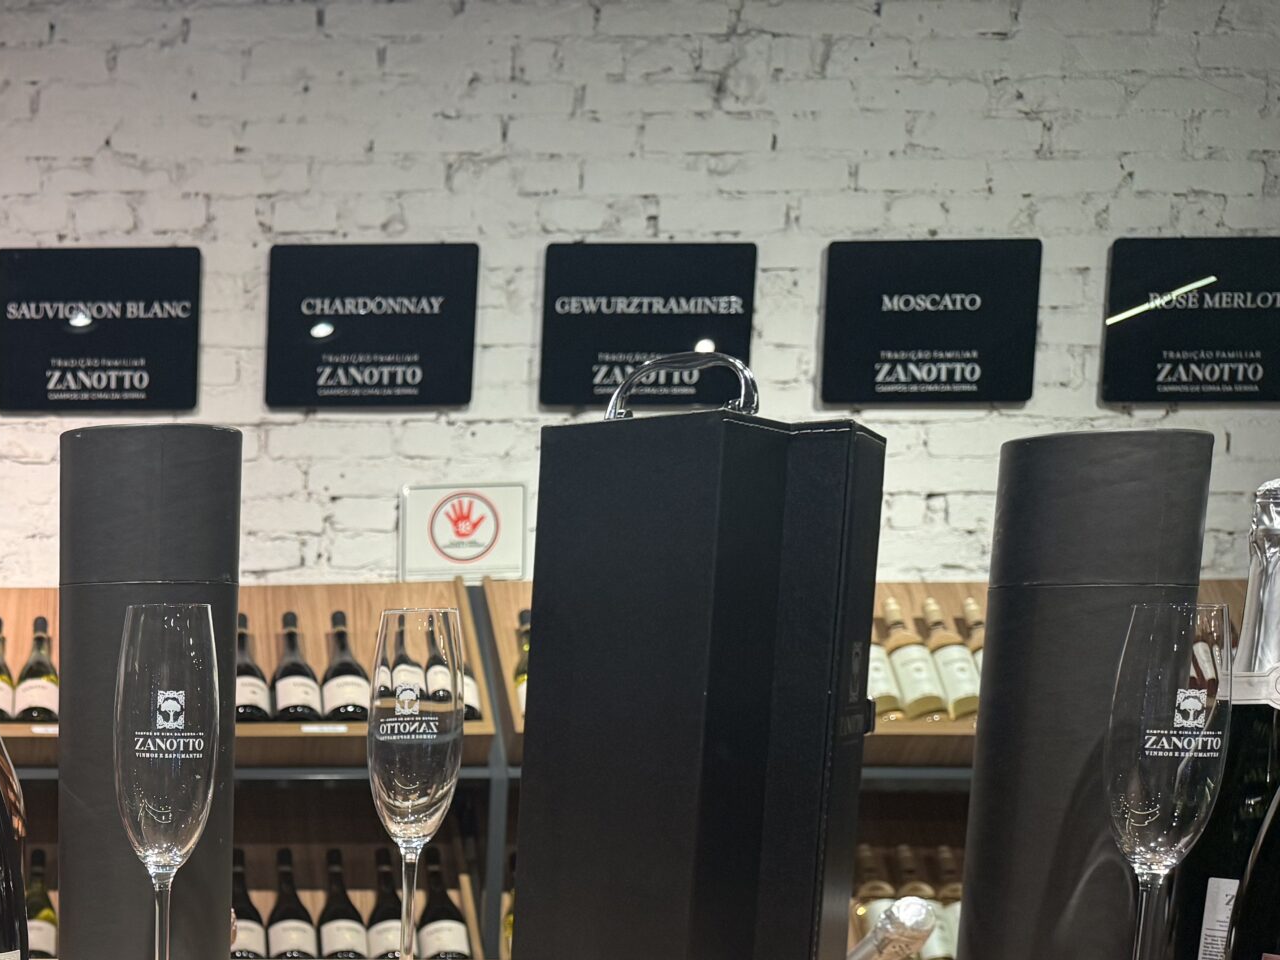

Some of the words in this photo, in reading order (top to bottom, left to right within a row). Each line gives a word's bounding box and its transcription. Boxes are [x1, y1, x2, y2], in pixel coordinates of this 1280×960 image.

[301, 296, 445, 315] CHARDONNAY
[881, 293, 982, 311] MOSCATO
[1203, 292, 1280, 309] MERLOT
[7, 302, 122, 319] SAUVIGNON
[126, 302, 191, 319] BLANC
[45, 369, 150, 390] ZANOTTO
[316, 366, 424, 386] ZANOTTO
[874, 362, 982, 383] ZANOTTO
[1156, 362, 1264, 383] ZANOTTO
[134, 737, 204, 751] ZANOTTO
[1144, 735, 1222, 750] ZANOTTO
